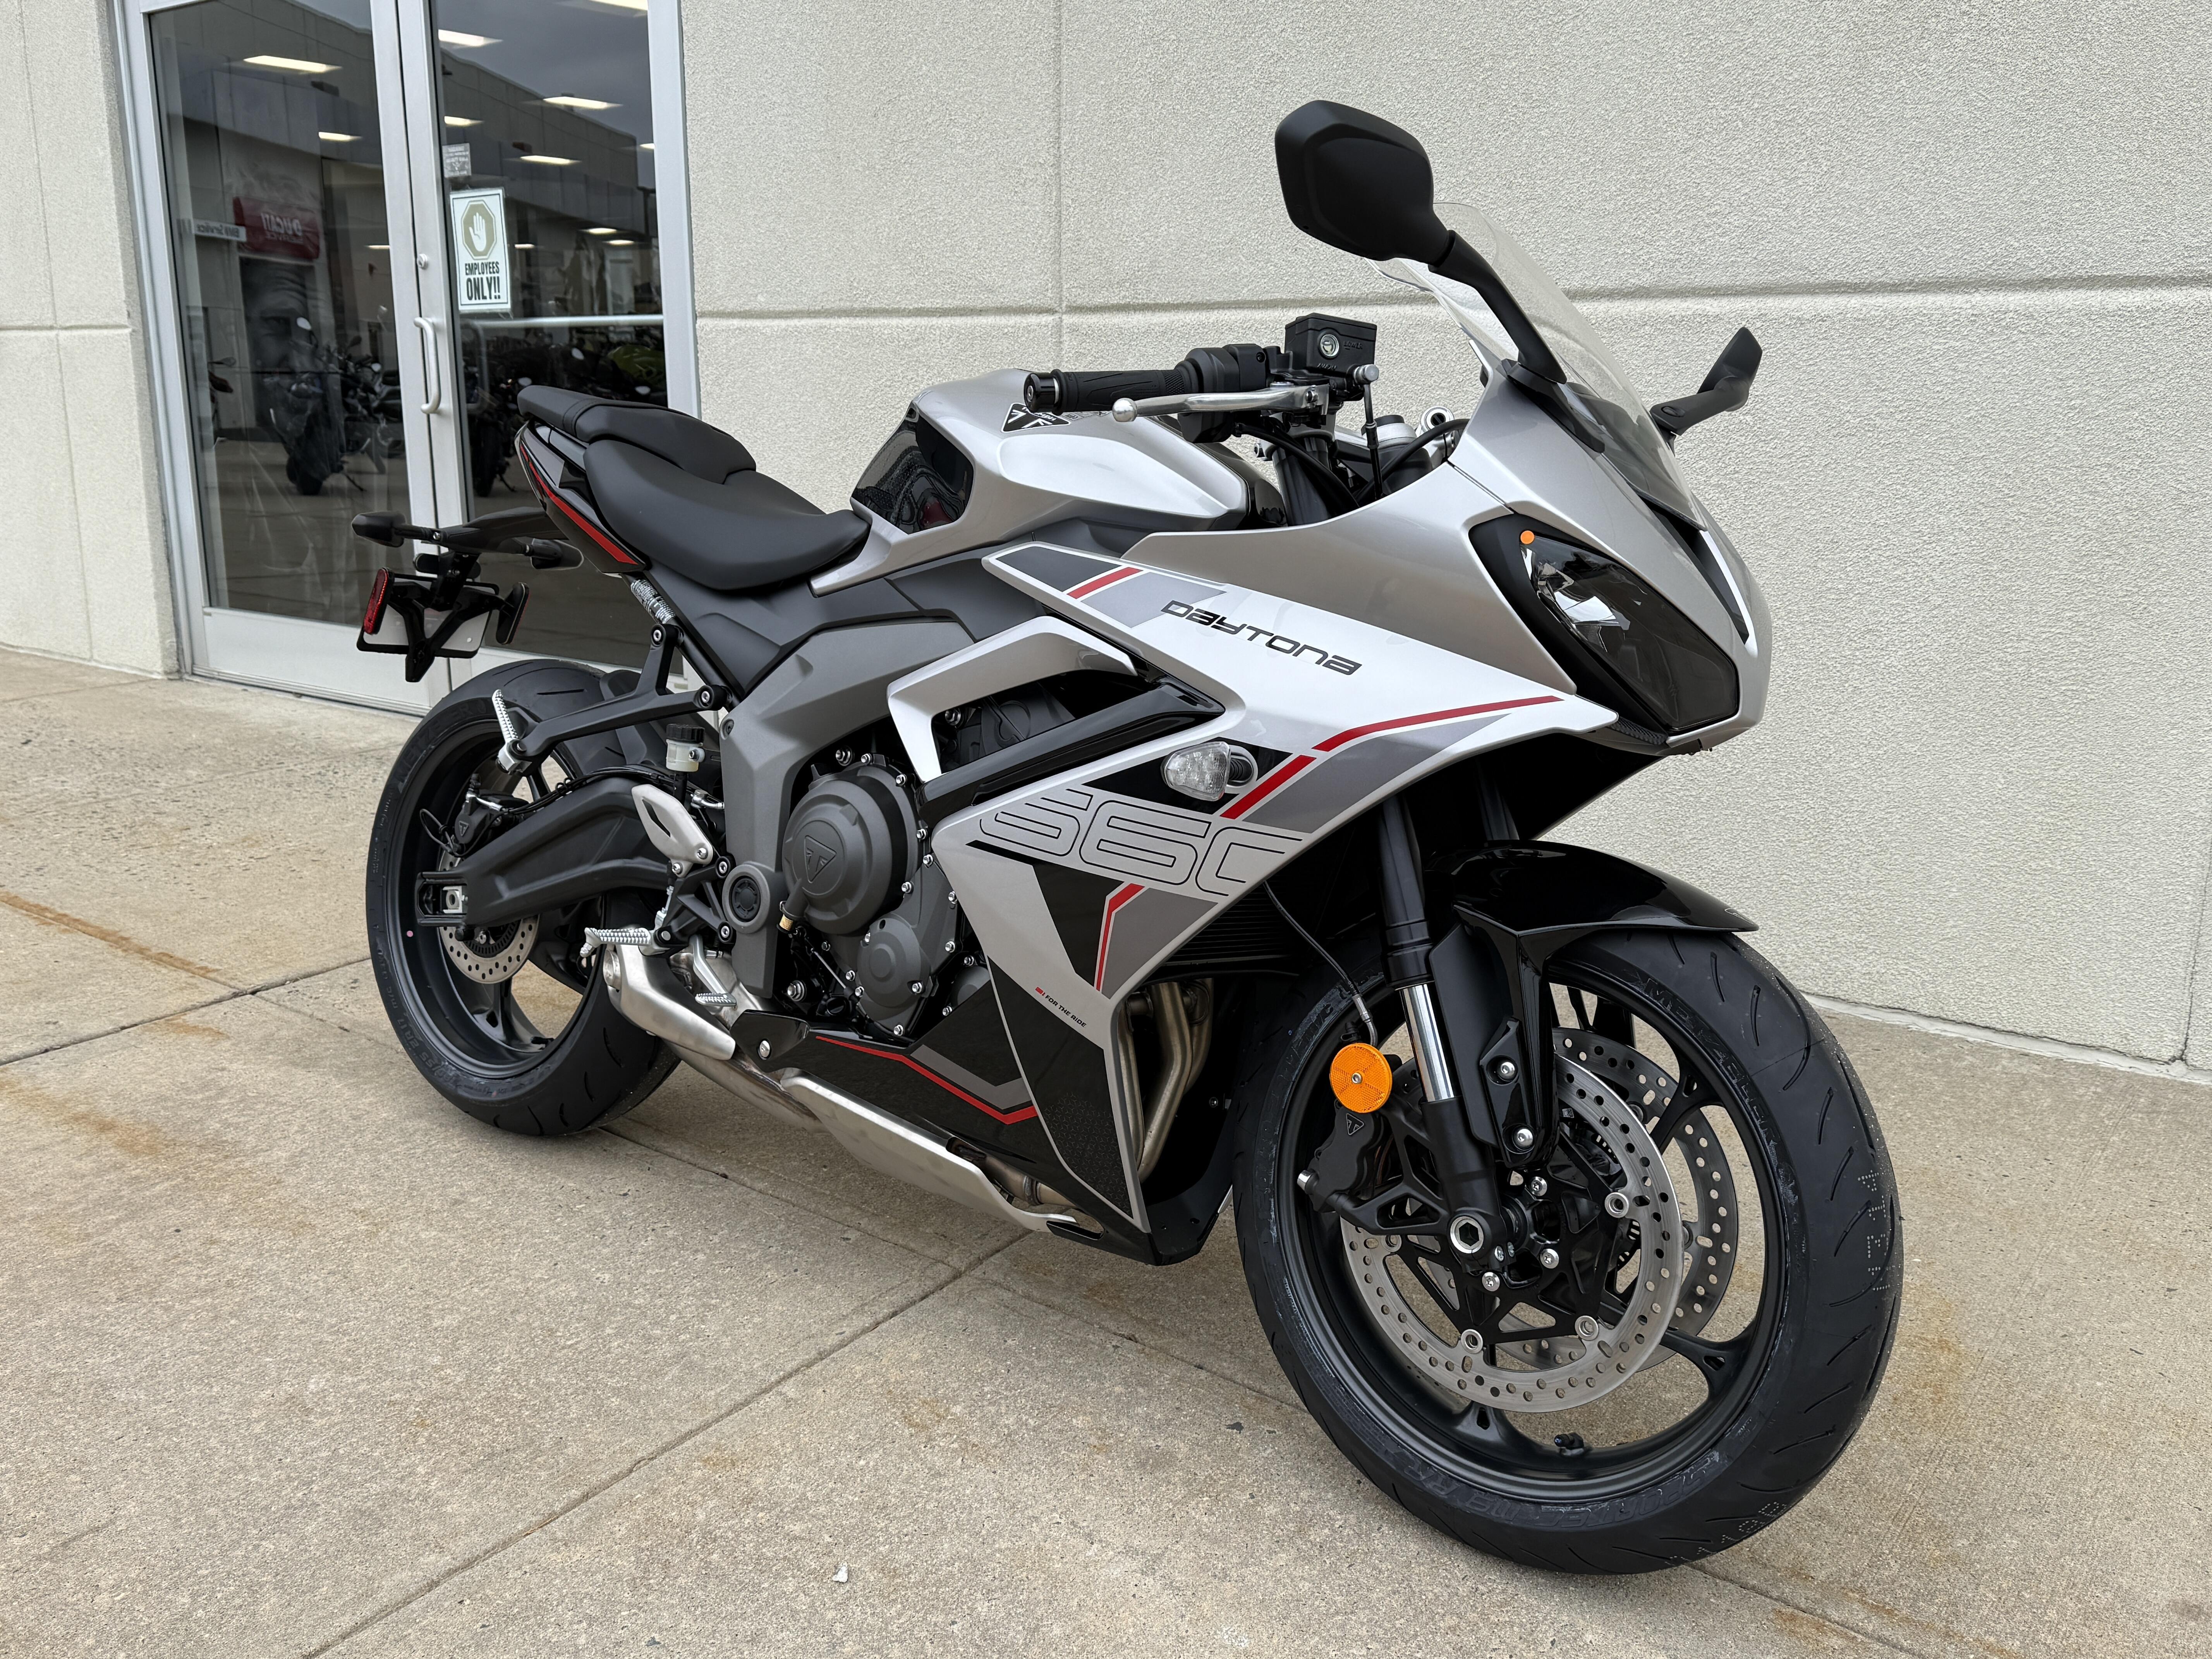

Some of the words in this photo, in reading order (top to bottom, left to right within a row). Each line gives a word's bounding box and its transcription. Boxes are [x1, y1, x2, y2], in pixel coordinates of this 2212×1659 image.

[465, 261, 500, 276] EMPLOYEES
[466, 276, 501, 301] ONLY!!
[1045, 995, 1058, 1006] FOR
[1058, 1005, 1071, 1016] THE
[1070, 1015, 1087, 1027] RIDE
